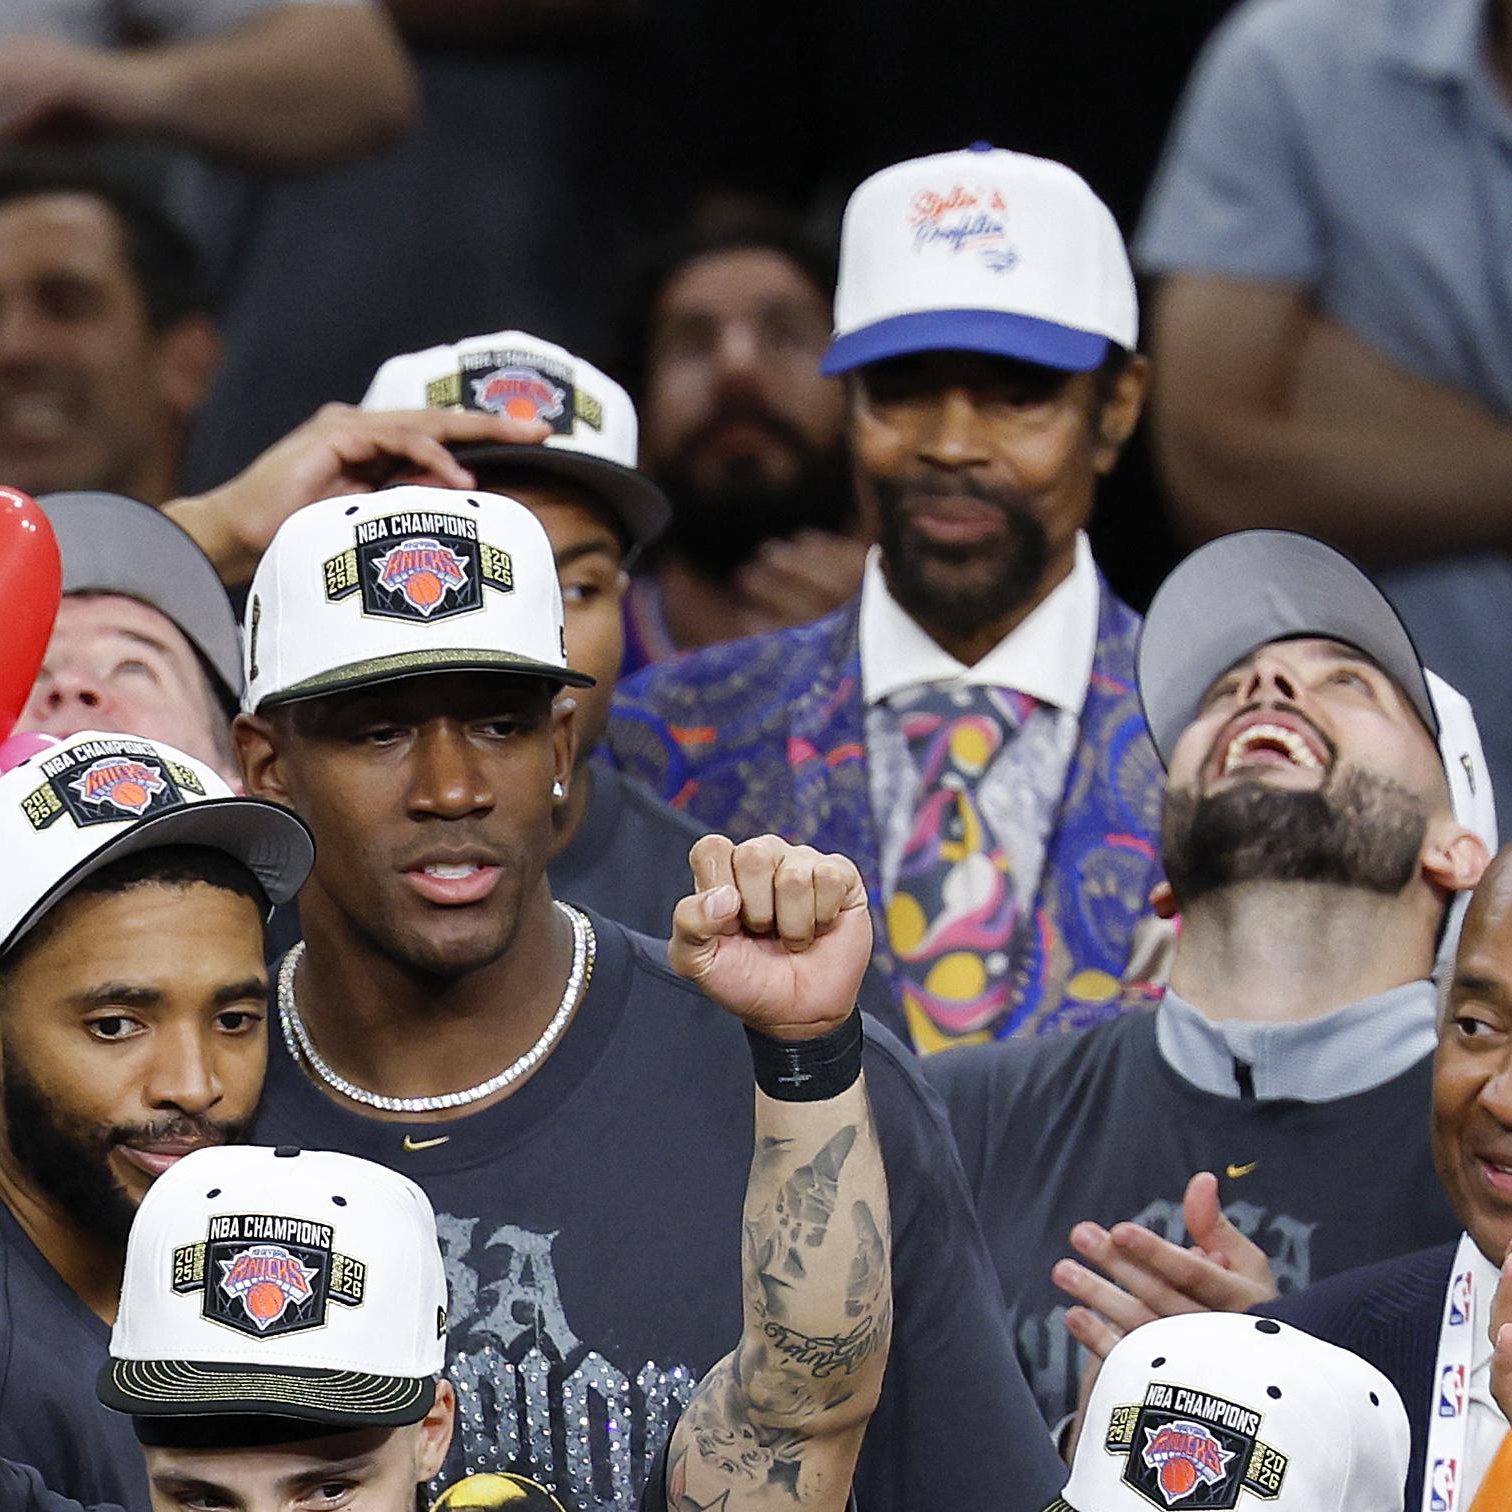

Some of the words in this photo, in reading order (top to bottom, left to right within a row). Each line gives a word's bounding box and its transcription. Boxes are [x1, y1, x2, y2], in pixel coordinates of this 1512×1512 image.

[357, 519, 388, 545] NBA
[391, 513, 477, 540] CHAMPIONS
[327, 556, 345, 576] 20
[384, 549, 463, 582] KNICKS
[491, 549, 510, 570] 20
[327, 572, 346, 594] 25
[492, 566, 512, 586] 26
[42, 755, 76, 778] NBA
[75, 740, 158, 763] CHAMPIONS
[24, 792, 44, 816] 20
[30, 805, 51, 826] 25
[210, 1217, 240, 1240] NBA
[243, 1216, 332, 1249] CHAMPIONS
[175, 1249, 193, 1267] 20
[174, 1266, 192, 1284] 25
[227, 1255, 309, 1292] KNICKS
[344, 1260, 364, 1279] 20
[343, 1277, 362, 1297] 26
[1112, 1408, 1129, 1426] 20
[1145, 1384, 1174, 1410] NBA
[1173, 1390, 1261, 1437] CHAMPIONS
[1109, 1424, 1126, 1443] 25
[1264, 1450, 1285, 1474] 20
[1258, 1467, 1281, 1490] 26
